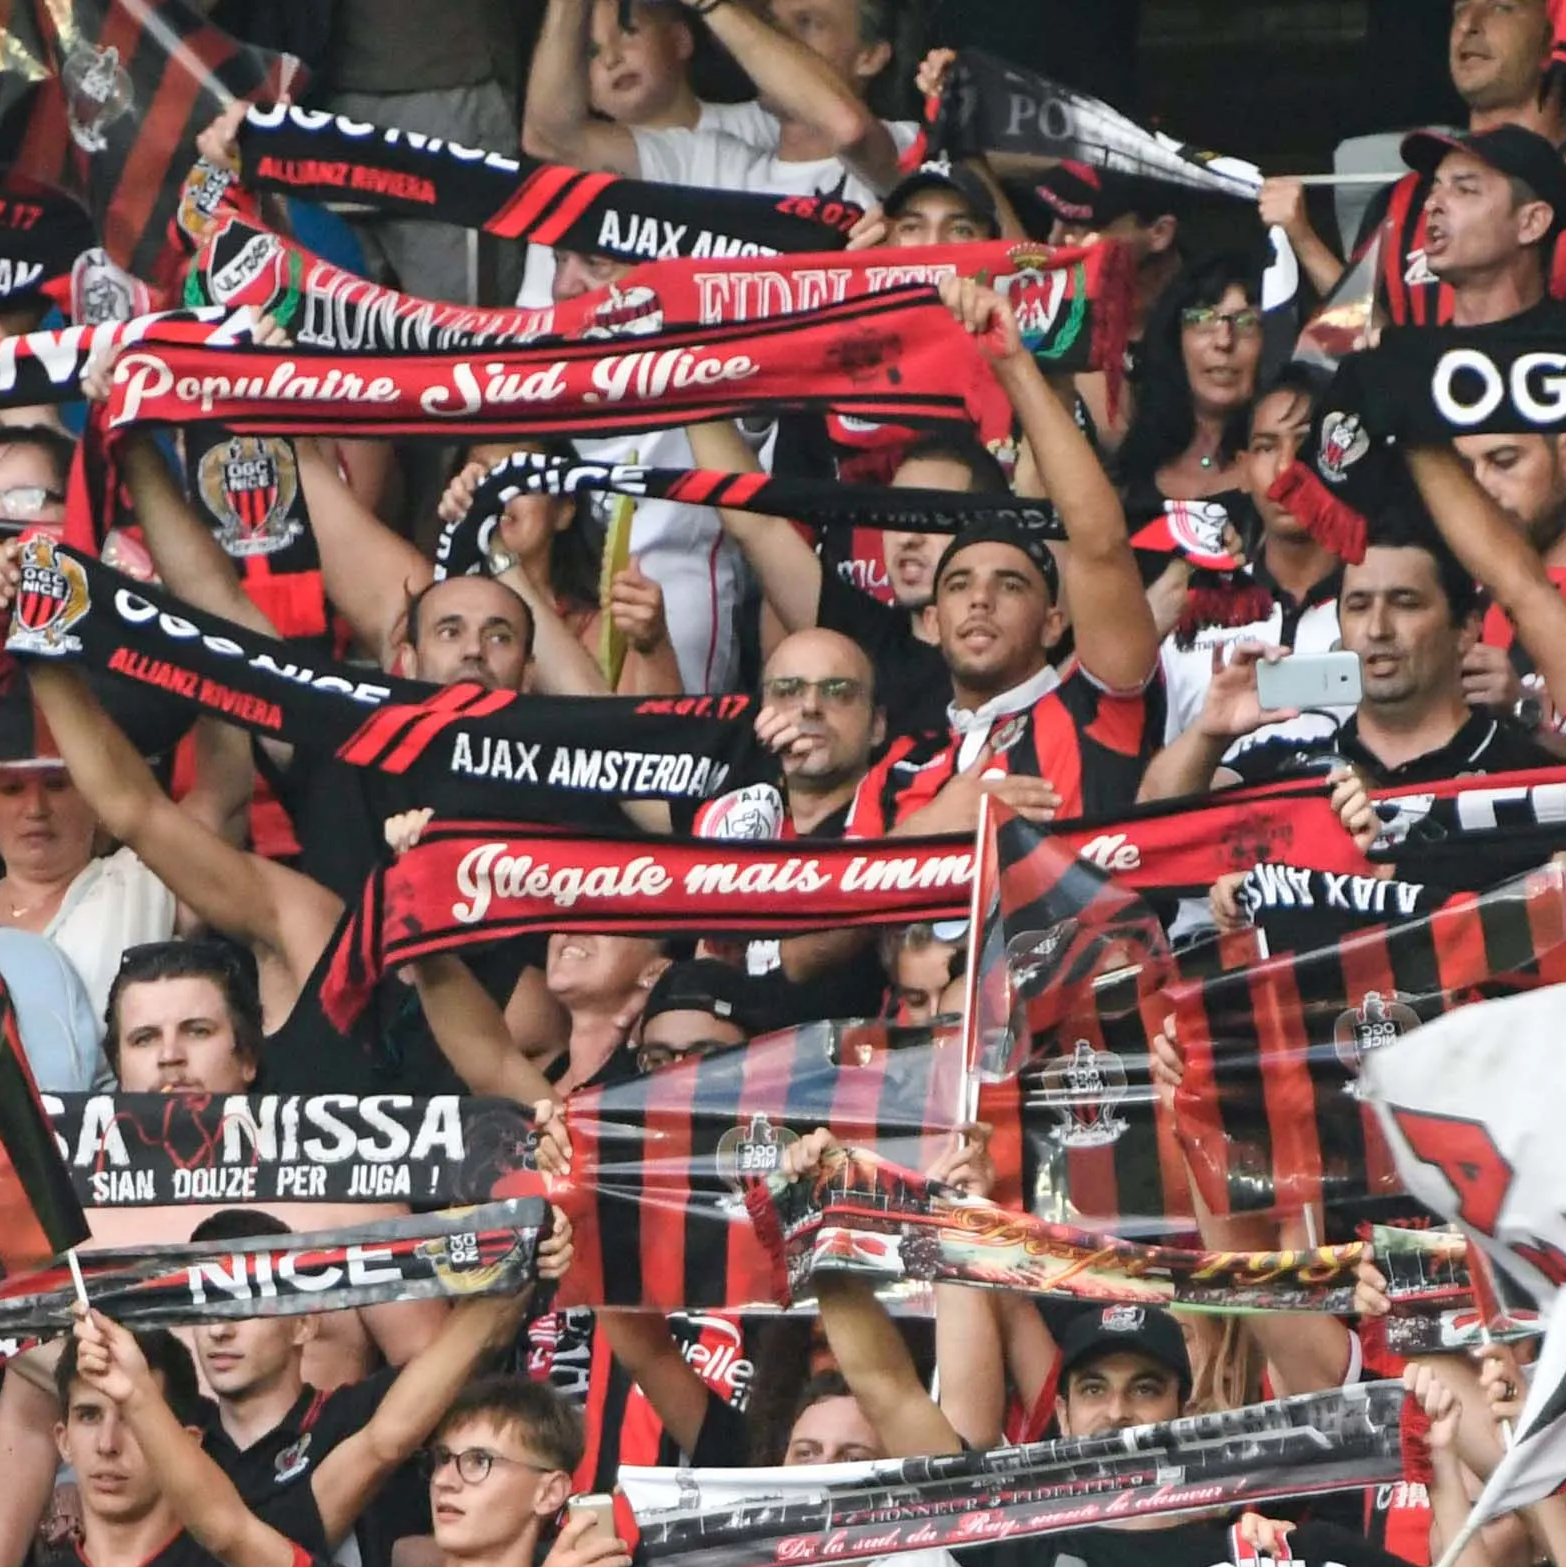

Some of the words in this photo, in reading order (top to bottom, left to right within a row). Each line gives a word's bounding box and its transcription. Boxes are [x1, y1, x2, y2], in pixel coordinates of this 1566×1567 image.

[598, 208, 685, 259] AJAX
[109, 352, 400, 429] Populaire
[420, 361, 575, 417] Sud
[583, 349, 760, 402] Nice
[227, 460, 274, 476] OGC
[227, 473, 273, 491] NICE
[20, 581, 67, 601] NICE
[22, 565, 66, 586] OGC
[450, 733, 539, 781] AJAX
[549, 746, 731, 803] AMSTERDAM
[451, 842, 672, 924] Illégale
[684, 856, 831, 899] mais
[224, 1093, 466, 1164] NISSA
[92, 1170, 154, 1202] SIAN
[173, 1167, 257, 1200] DOUZE
[277, 1165, 327, 1198] PER
[347, 1165, 411, 1197] JUGA
[189, 1246, 403, 1304] NICE
